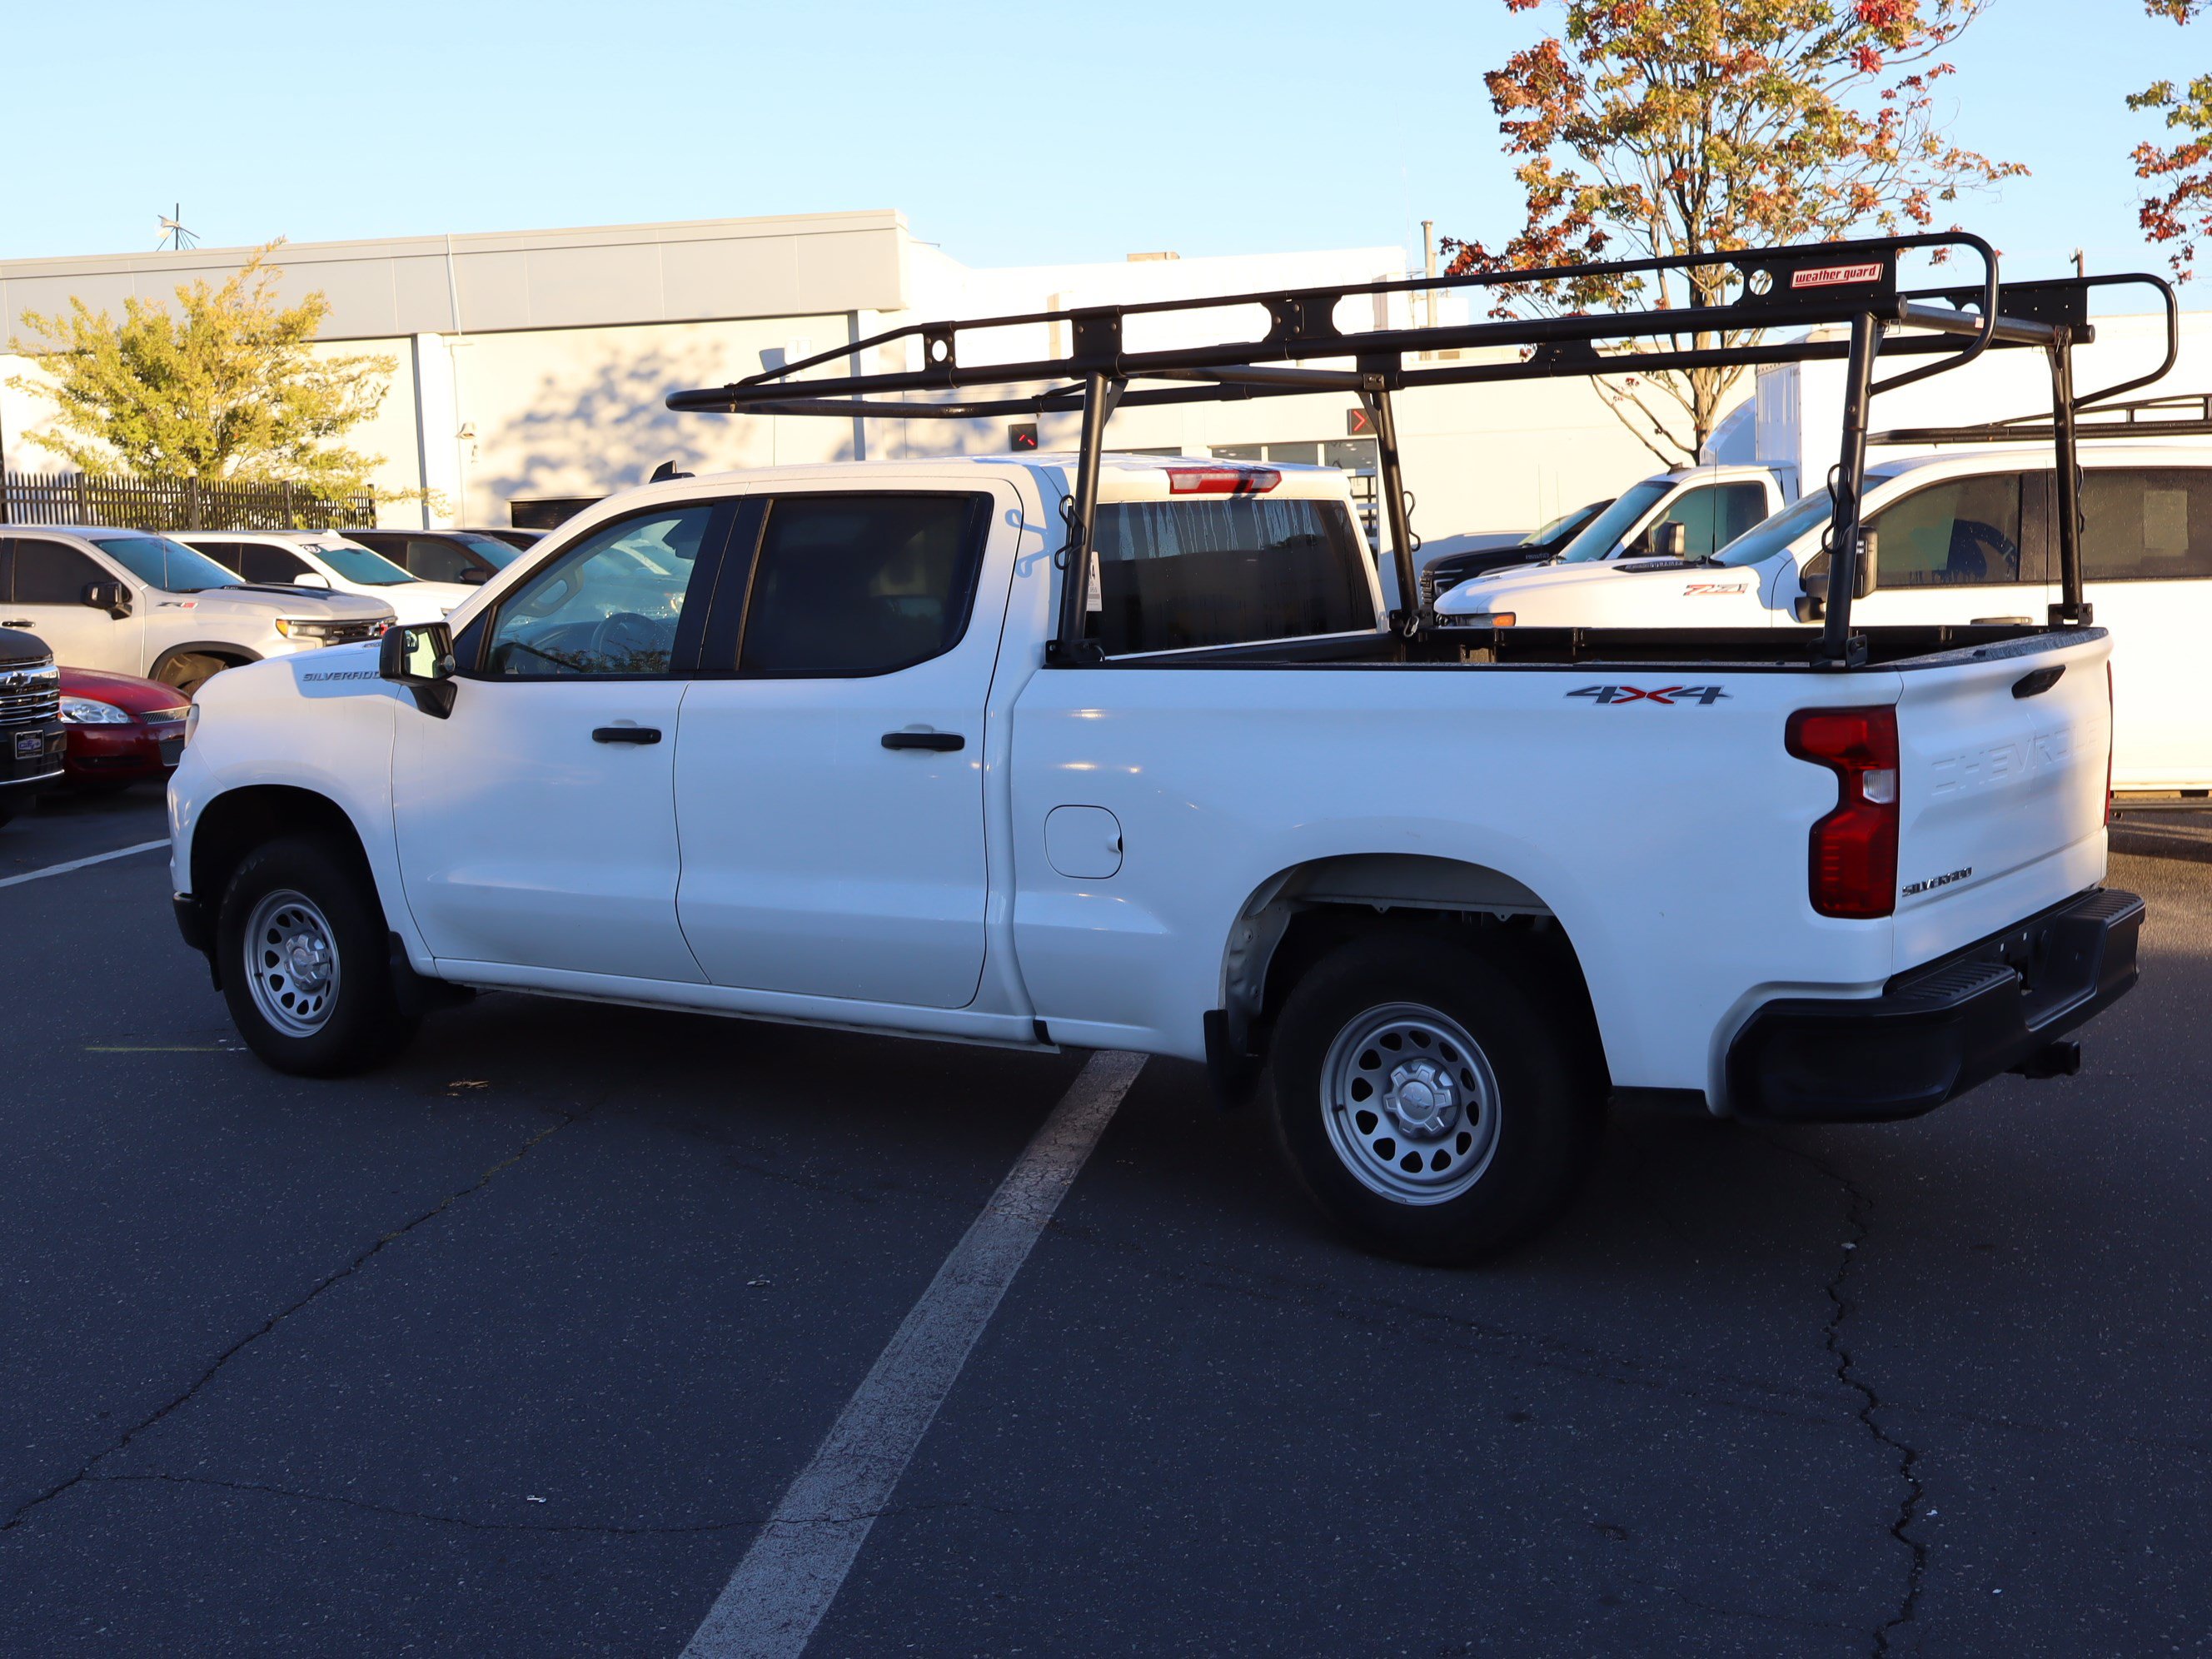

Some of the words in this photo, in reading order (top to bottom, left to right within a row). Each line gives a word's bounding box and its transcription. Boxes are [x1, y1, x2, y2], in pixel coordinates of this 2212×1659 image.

[1796, 270, 1841, 283] weather
[1843, 266, 1876, 281] guard
[303, 671, 381, 682] SILVERADO
[1901, 867, 1973, 898] SILVERADO
